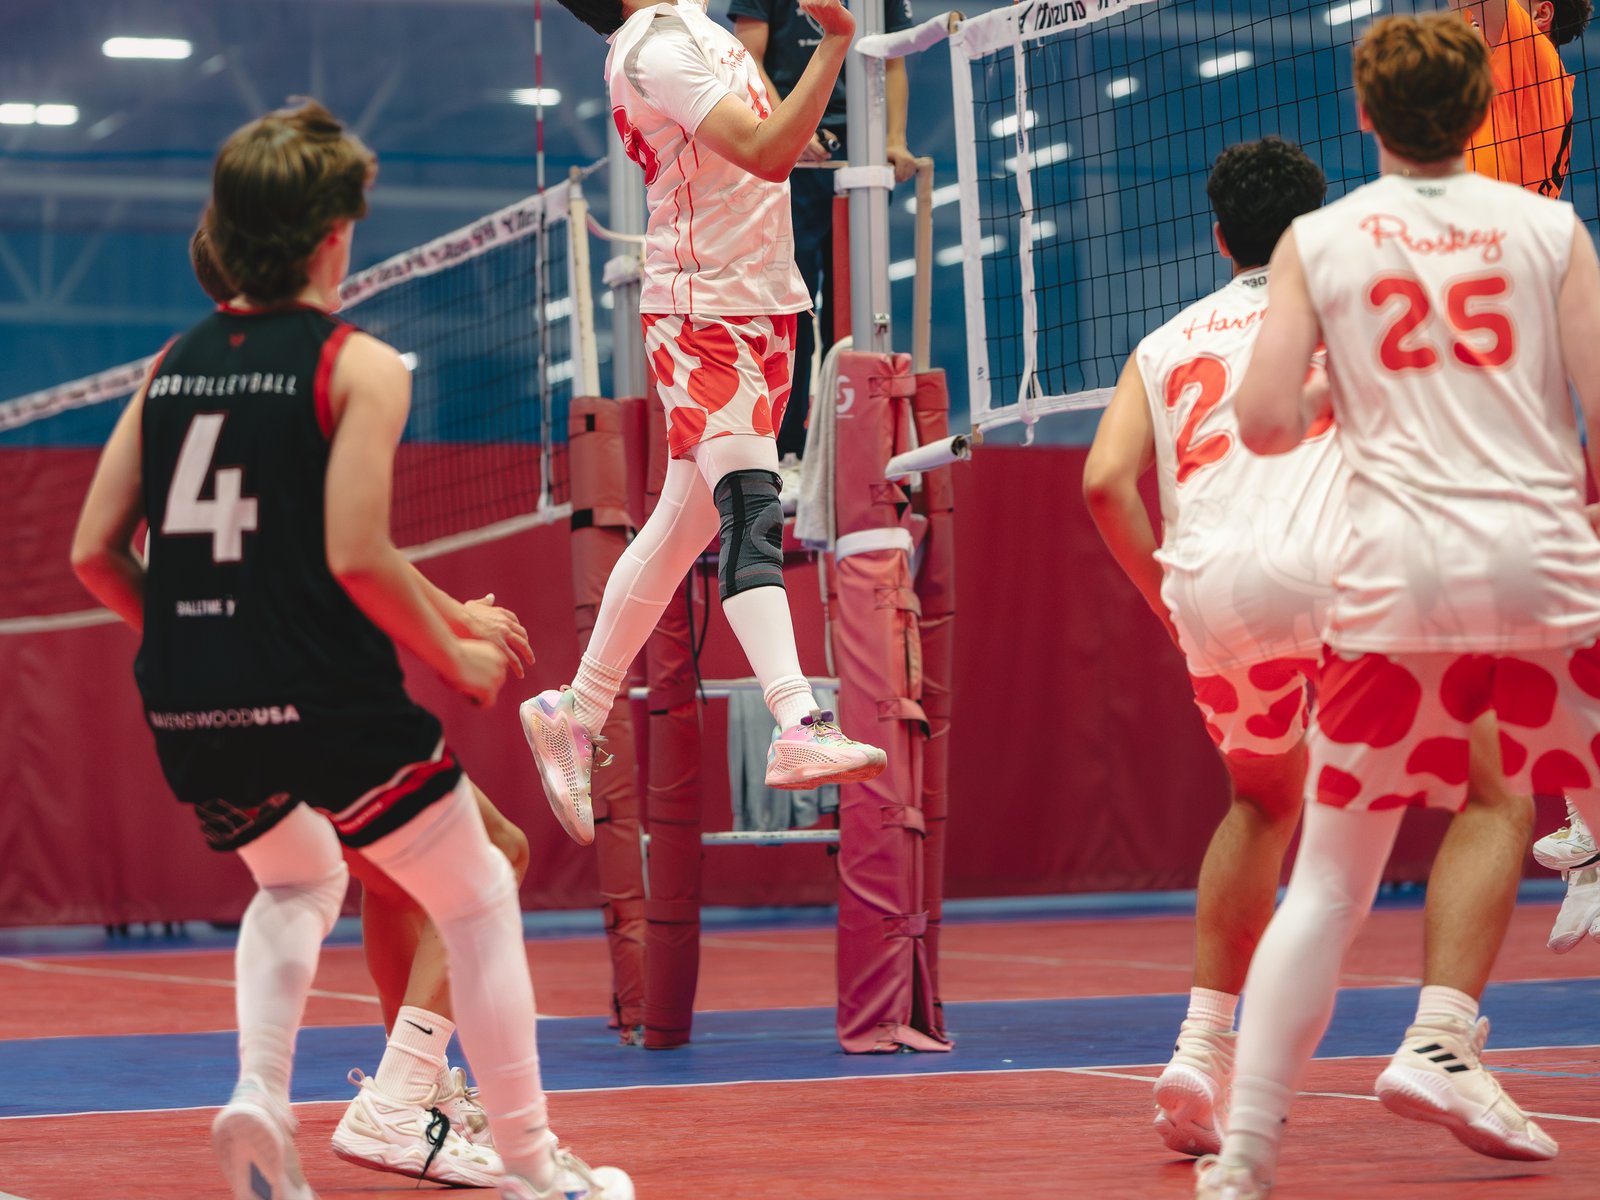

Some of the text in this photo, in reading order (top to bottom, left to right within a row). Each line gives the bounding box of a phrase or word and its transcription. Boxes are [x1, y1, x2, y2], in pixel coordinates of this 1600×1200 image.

[1359, 213, 1506, 264] Proskey
[1368, 274, 1515, 373] 25
[161, 412, 258, 563] 4
